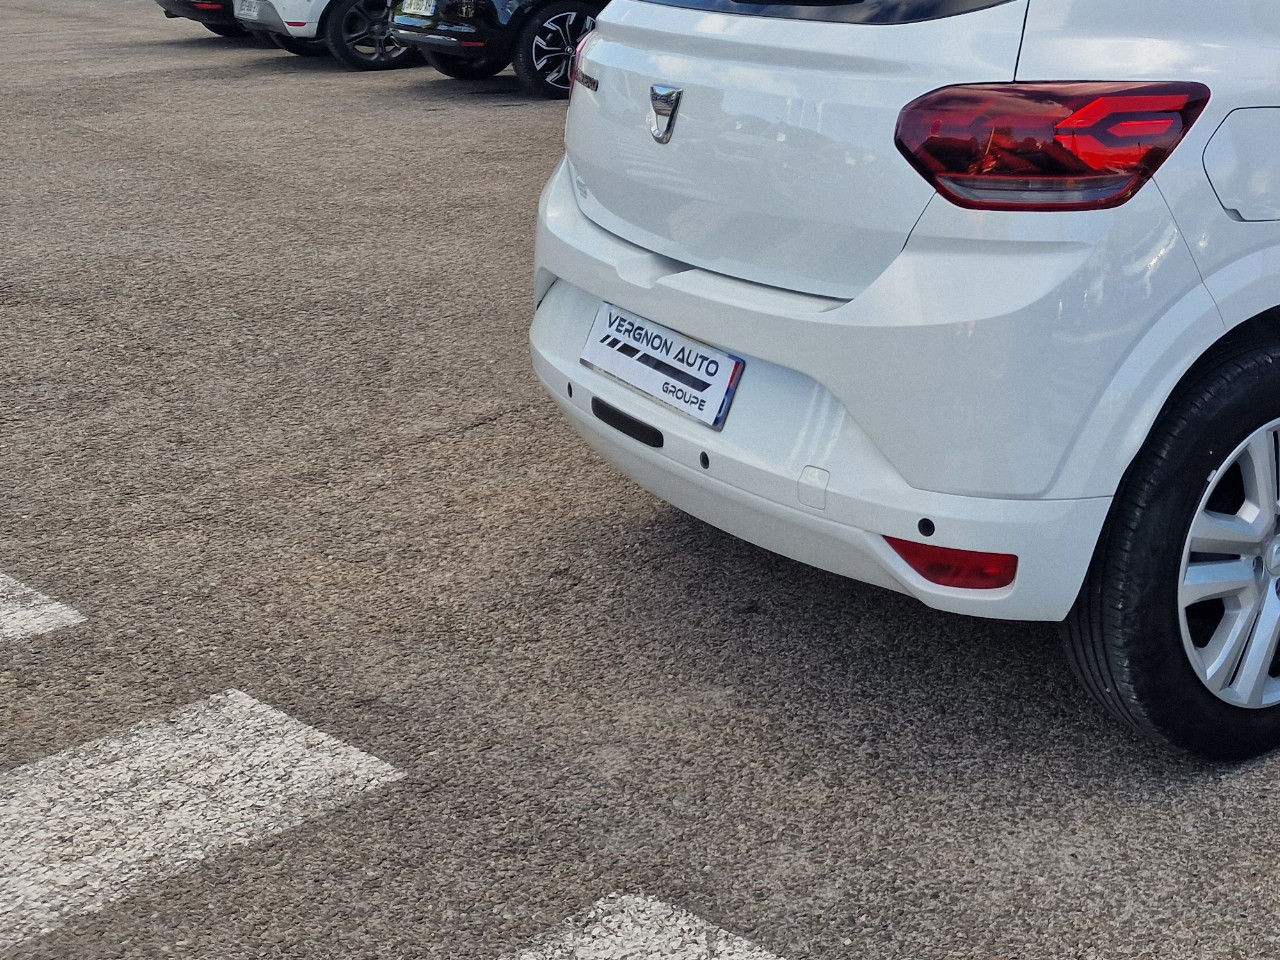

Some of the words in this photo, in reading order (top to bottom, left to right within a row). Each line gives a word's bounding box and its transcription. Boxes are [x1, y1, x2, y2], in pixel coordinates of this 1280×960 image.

[607, 311, 674, 357] VERGNON
[673, 346, 719, 377] AUTO
[661, 382, 707, 411] GROUPE
